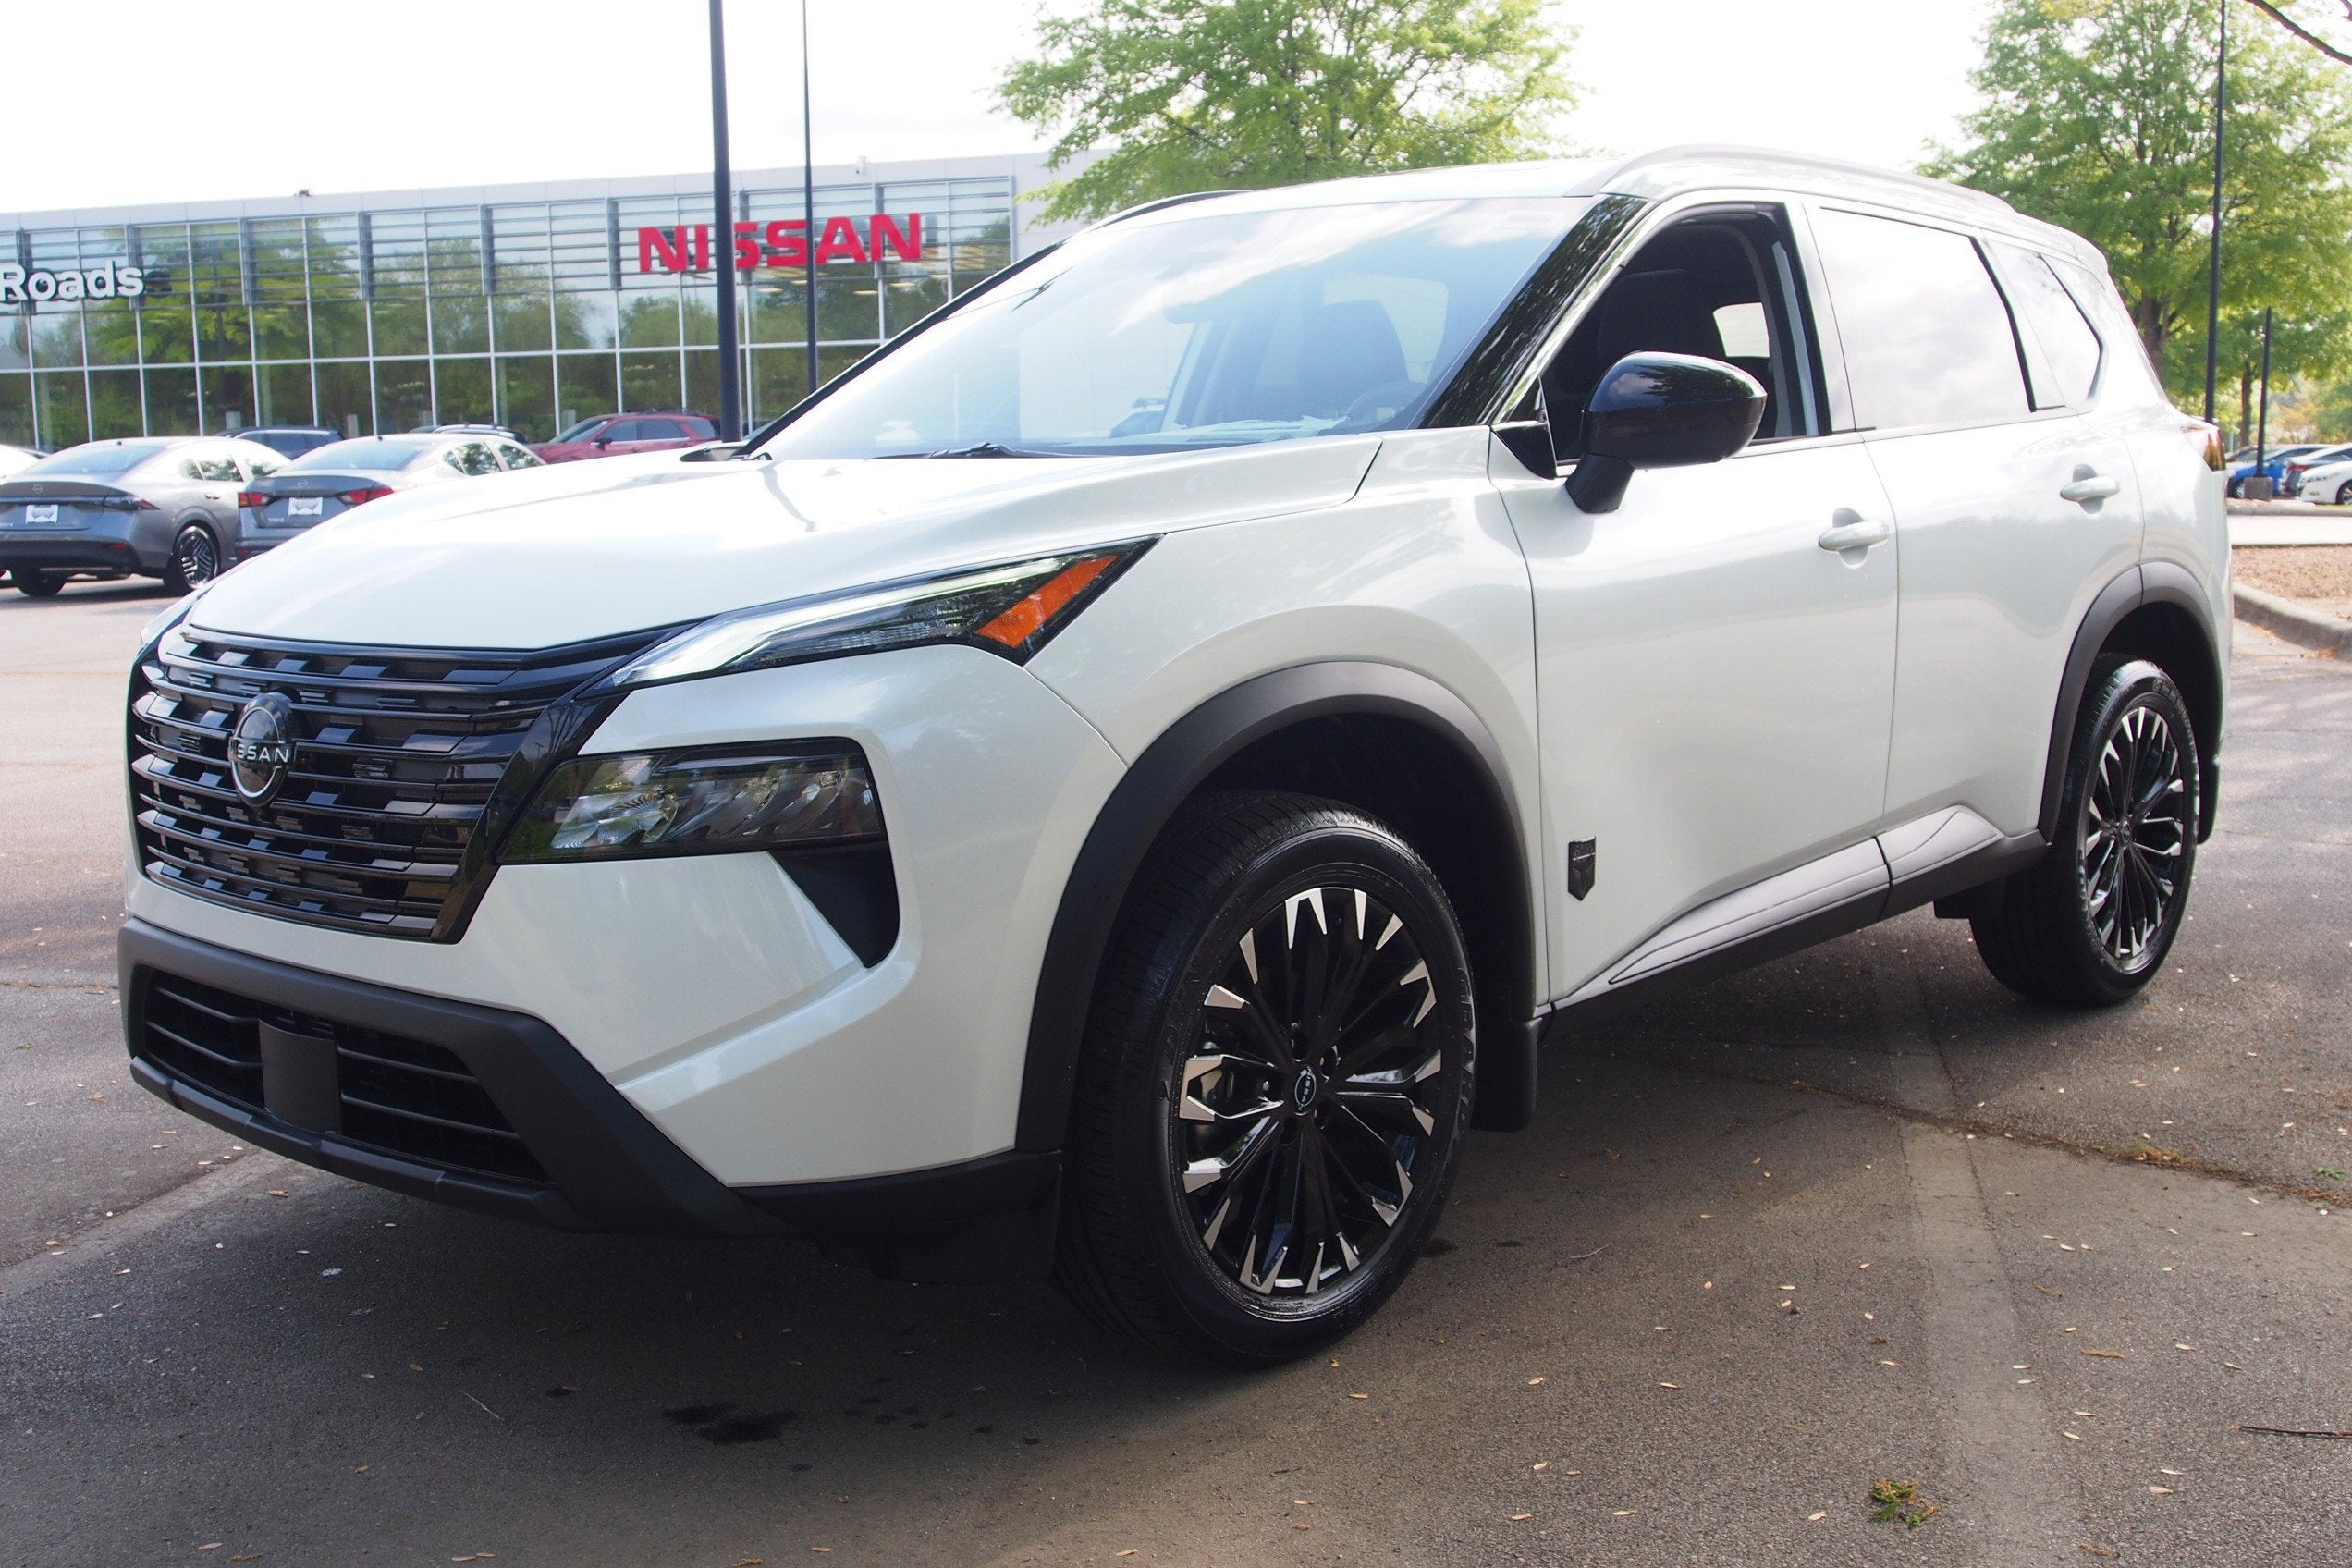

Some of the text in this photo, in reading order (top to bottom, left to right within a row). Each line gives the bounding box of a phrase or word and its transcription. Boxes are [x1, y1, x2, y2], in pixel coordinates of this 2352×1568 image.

[638, 213, 922, 272] NISSAN
[0, 259, 144, 301] Roads
[237, 743, 289, 764] SSAN
